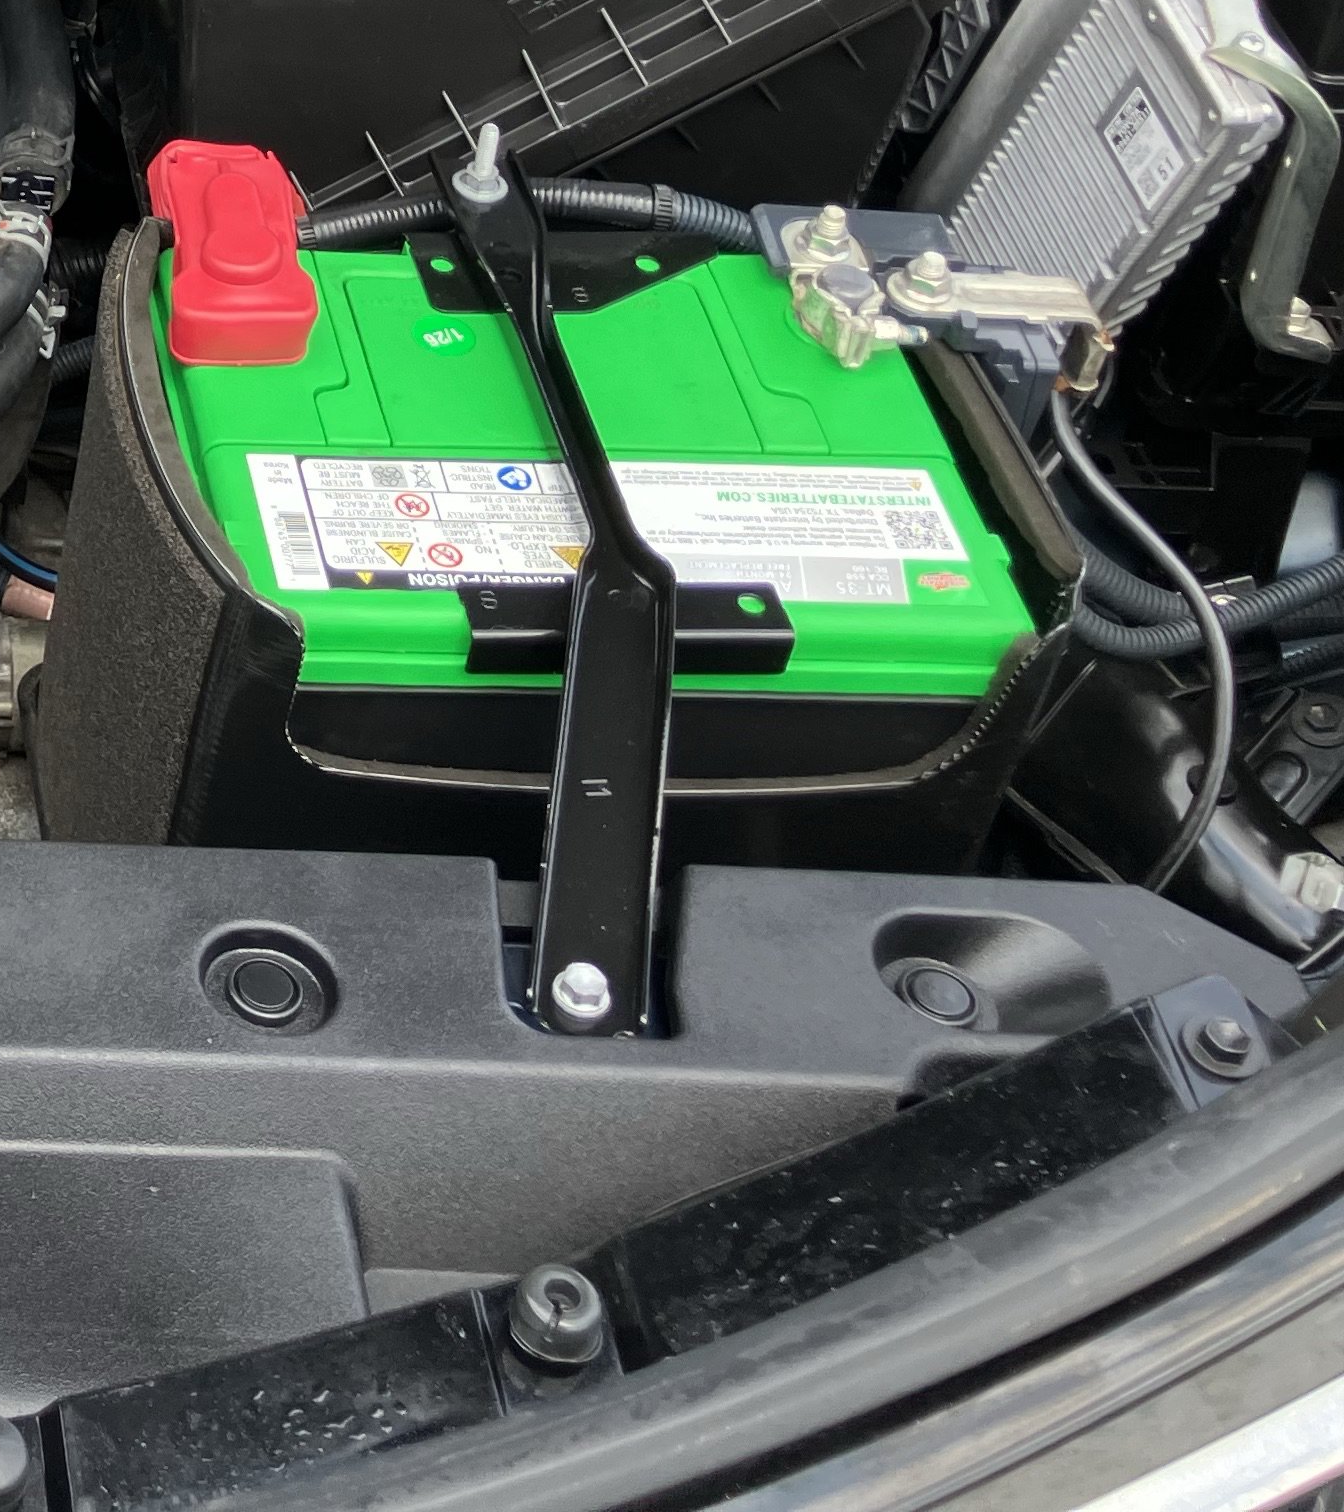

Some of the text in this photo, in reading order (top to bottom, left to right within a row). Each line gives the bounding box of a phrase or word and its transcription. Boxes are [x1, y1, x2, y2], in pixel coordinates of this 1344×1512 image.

[263, 461, 289, 469] Korea
[320, 479, 363, 487] BATTERY
[525, 496, 567, 504] MEDICAL
[716, 491, 931, 506] INTERSTATEBATTERIES.COM
[336, 500, 369, 508] REACH
[331, 508, 393, 517] KEEP OUT OF
[447, 511, 512, 519] IMMEDIATELY
[718, 515, 761, 523] Batteries
[764, 516, 810, 524] Interstate
[326, 529, 411, 537] CAUSE BLINDNESS
[350, 547, 375, 555] ACID
[332, 555, 386, 565] SULFURIC
[524, 560, 563, 568] SHIELD
[688, 560, 763, 570] REPLACEMENT
[736, 570, 775, 579] MONTH
